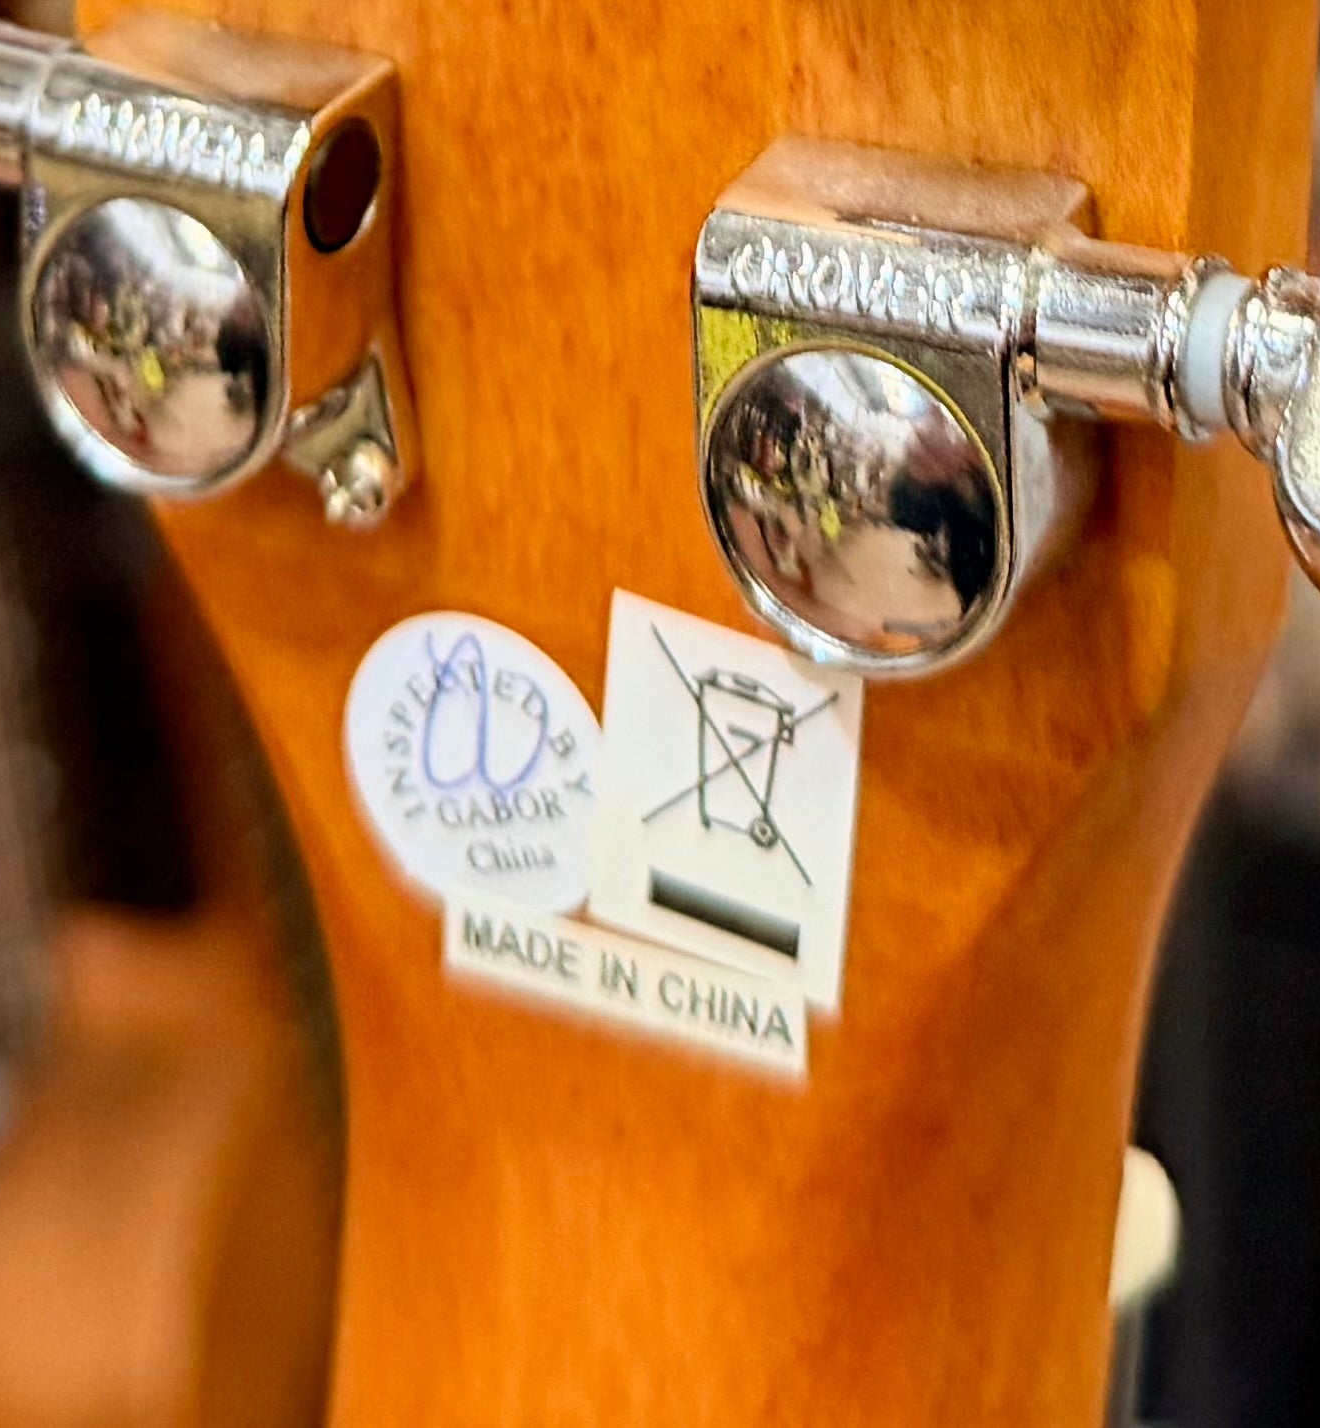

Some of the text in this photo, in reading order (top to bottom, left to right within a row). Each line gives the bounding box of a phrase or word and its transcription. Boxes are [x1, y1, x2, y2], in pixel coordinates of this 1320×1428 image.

[437, 786, 568, 830] GABOR
[465, 836, 558, 874] China
[461, 912, 796, 1048] MADE IN CHINA
